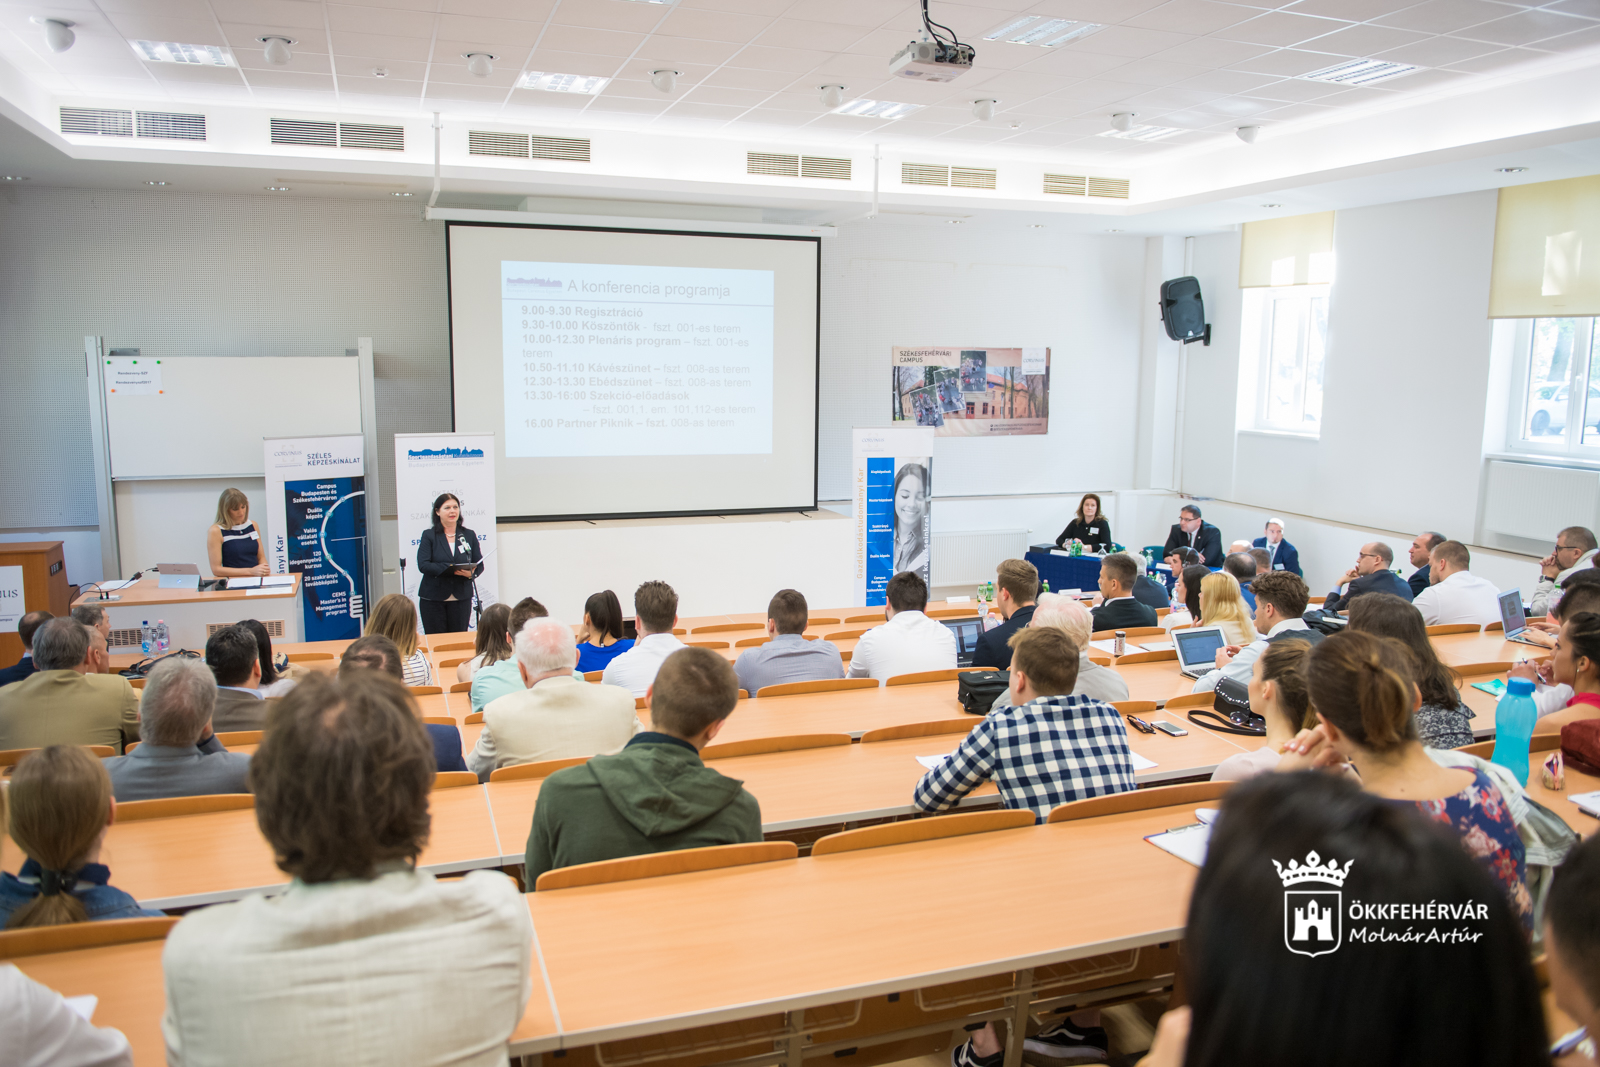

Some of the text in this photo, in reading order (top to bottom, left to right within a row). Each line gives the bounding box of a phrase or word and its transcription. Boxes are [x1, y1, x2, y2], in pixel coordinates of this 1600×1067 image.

[568, 280, 730, 300] A konferencia programja
[522, 305, 643, 318] 9.00-9.30 Regisztráció
[522, 320, 578, 331] 9.30-10.00
[582, 320, 640, 332] Köszöntők
[653, 322, 674, 333] fszt.
[677, 323, 710, 333] 001-es
[713, 324, 741, 334] terem
[523, 334, 585, 344] 10.00-12.30
[588, 335, 632, 346] Plenáris
[636, 337, 681, 347] program
[693, 337, 712, 347] fszt.
[716, 338, 749, 348] 001-es
[522, 349, 552, 358] terem
[524, 363, 585, 373] 10.50-11.10
[588, 363, 651, 374] Kávészünet
[663, 364, 683, 374] fszt.
[686, 364, 720, 374] 008-as
[723, 365, 750, 374] terem
[524, 377, 585, 387] 12.30-13.30
[589, 377, 652, 387] Ebédszünet
[664, 377, 684, 388] fszt.
[688, 378, 721, 387] 008-as
[724, 379, 751, 387] terem
[524, 390, 690, 401] 13.30-16:00 Szekció-előadások
[593, 404, 614, 414] fszt.
[728, 406, 756, 414] terem
[525, 419, 553, 428] 16.00
[557, 419, 597, 428] Partner
[600, 418, 633, 428] Piknik
[646, 418, 668, 428] fszt.
[707, 419, 734, 428] terem
[856, 485, 865, 579] Gazdálkodástudományi
[315, 603, 347, 611] Management
